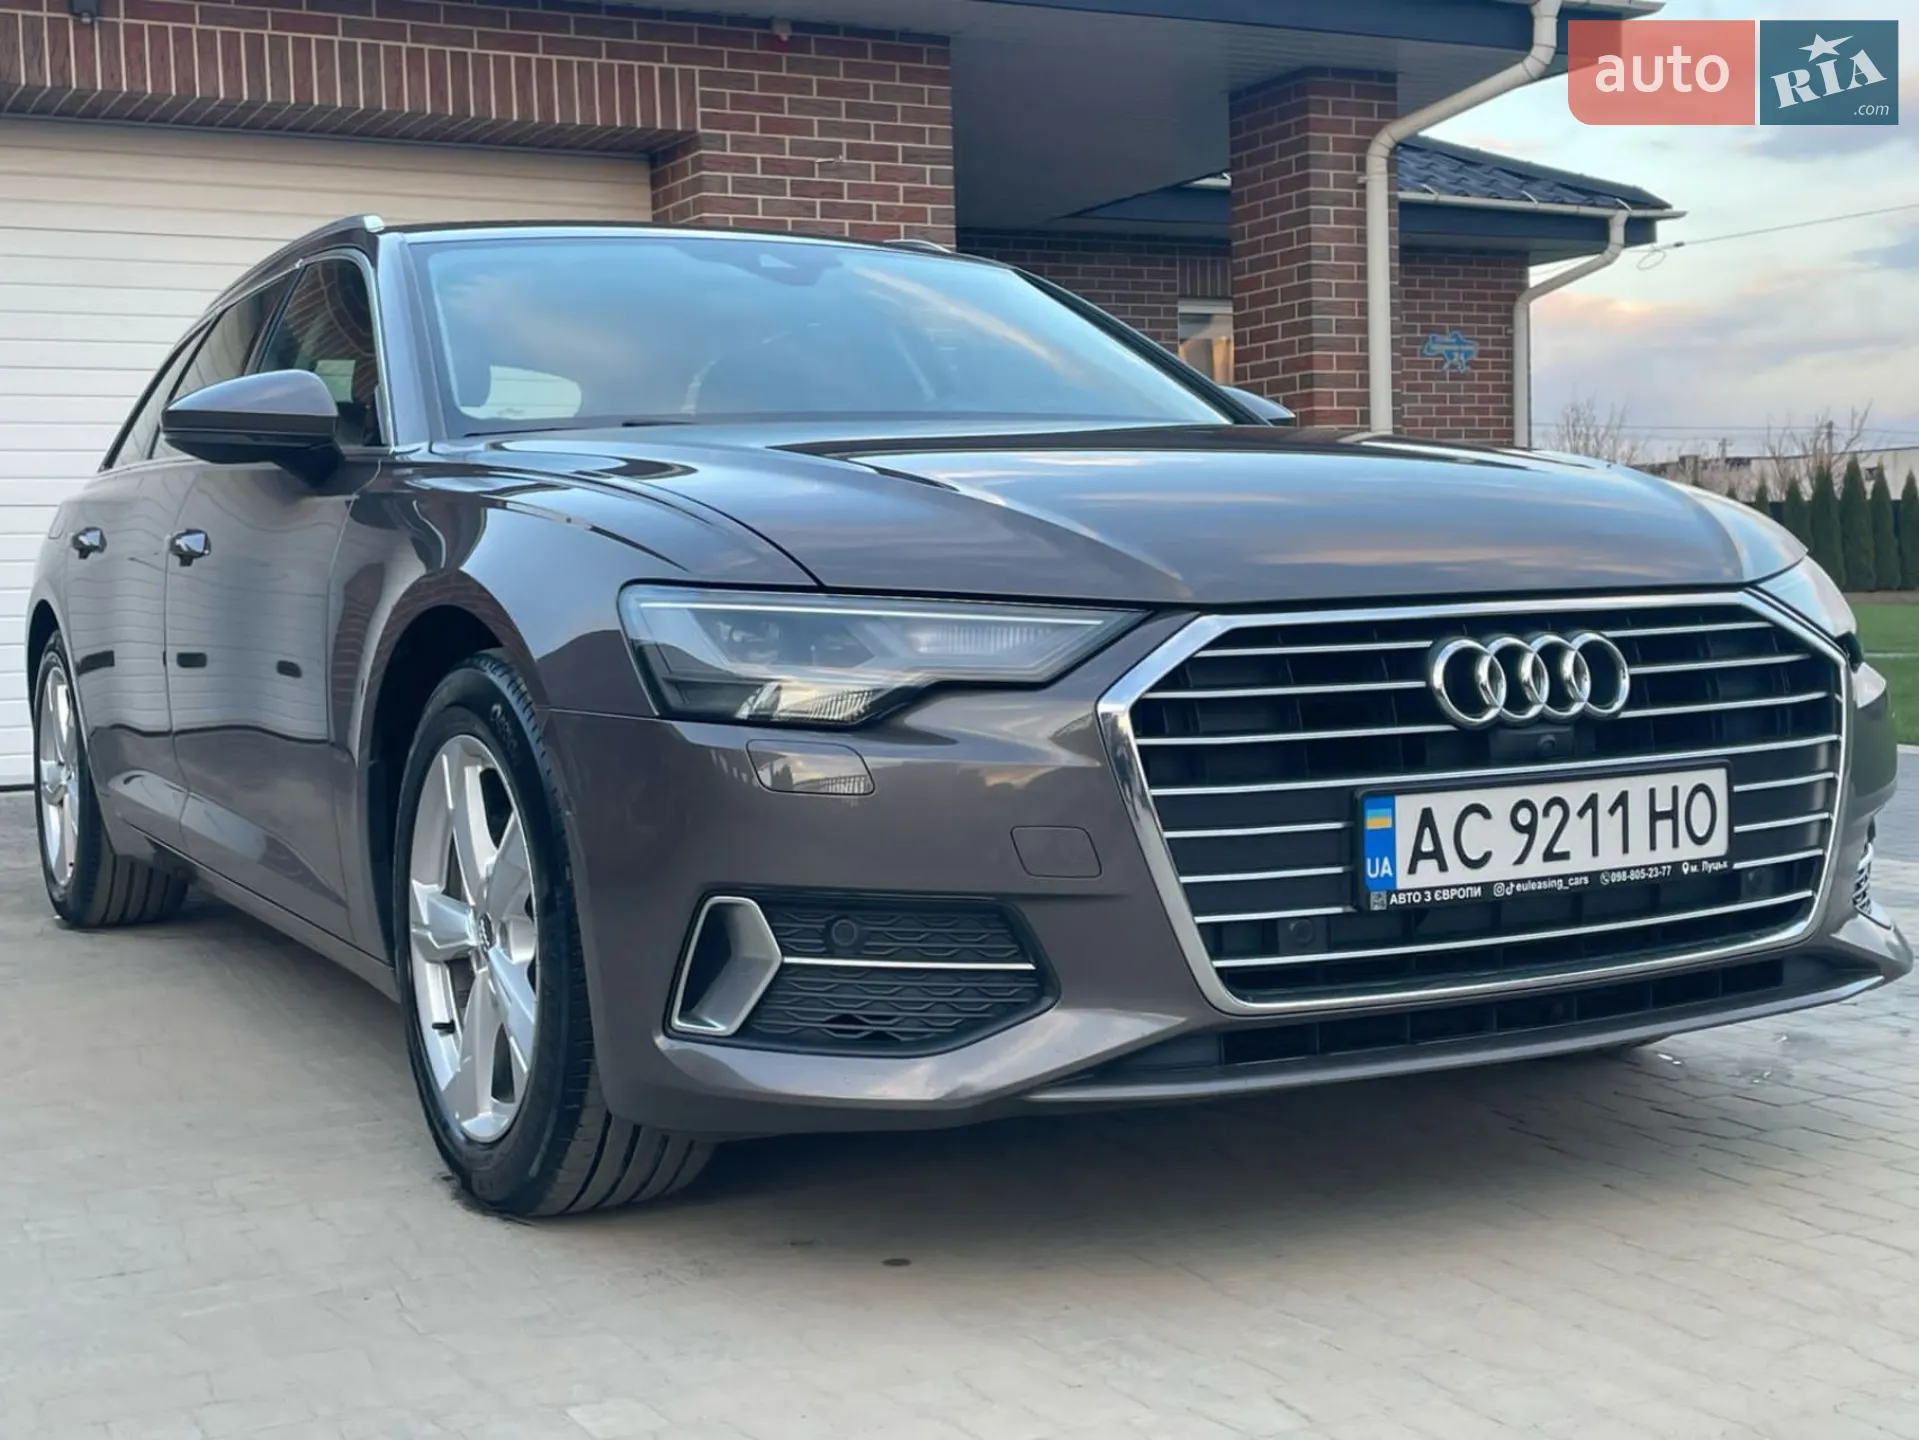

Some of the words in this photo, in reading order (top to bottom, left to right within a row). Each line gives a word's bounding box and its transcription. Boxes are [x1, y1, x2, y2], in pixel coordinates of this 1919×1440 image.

[1406, 802, 1493, 876] AC
[1509, 790, 1630, 866] 9211
[1366, 856, 1393, 879] UA
[1610, 865, 1672, 883] 098-805-23-77
[1516, 875, 1590, 892] euleasing_cars
[1389, 891, 1423, 906] АВТО
[1434, 886, 1482, 902] ЄВРОПИ
